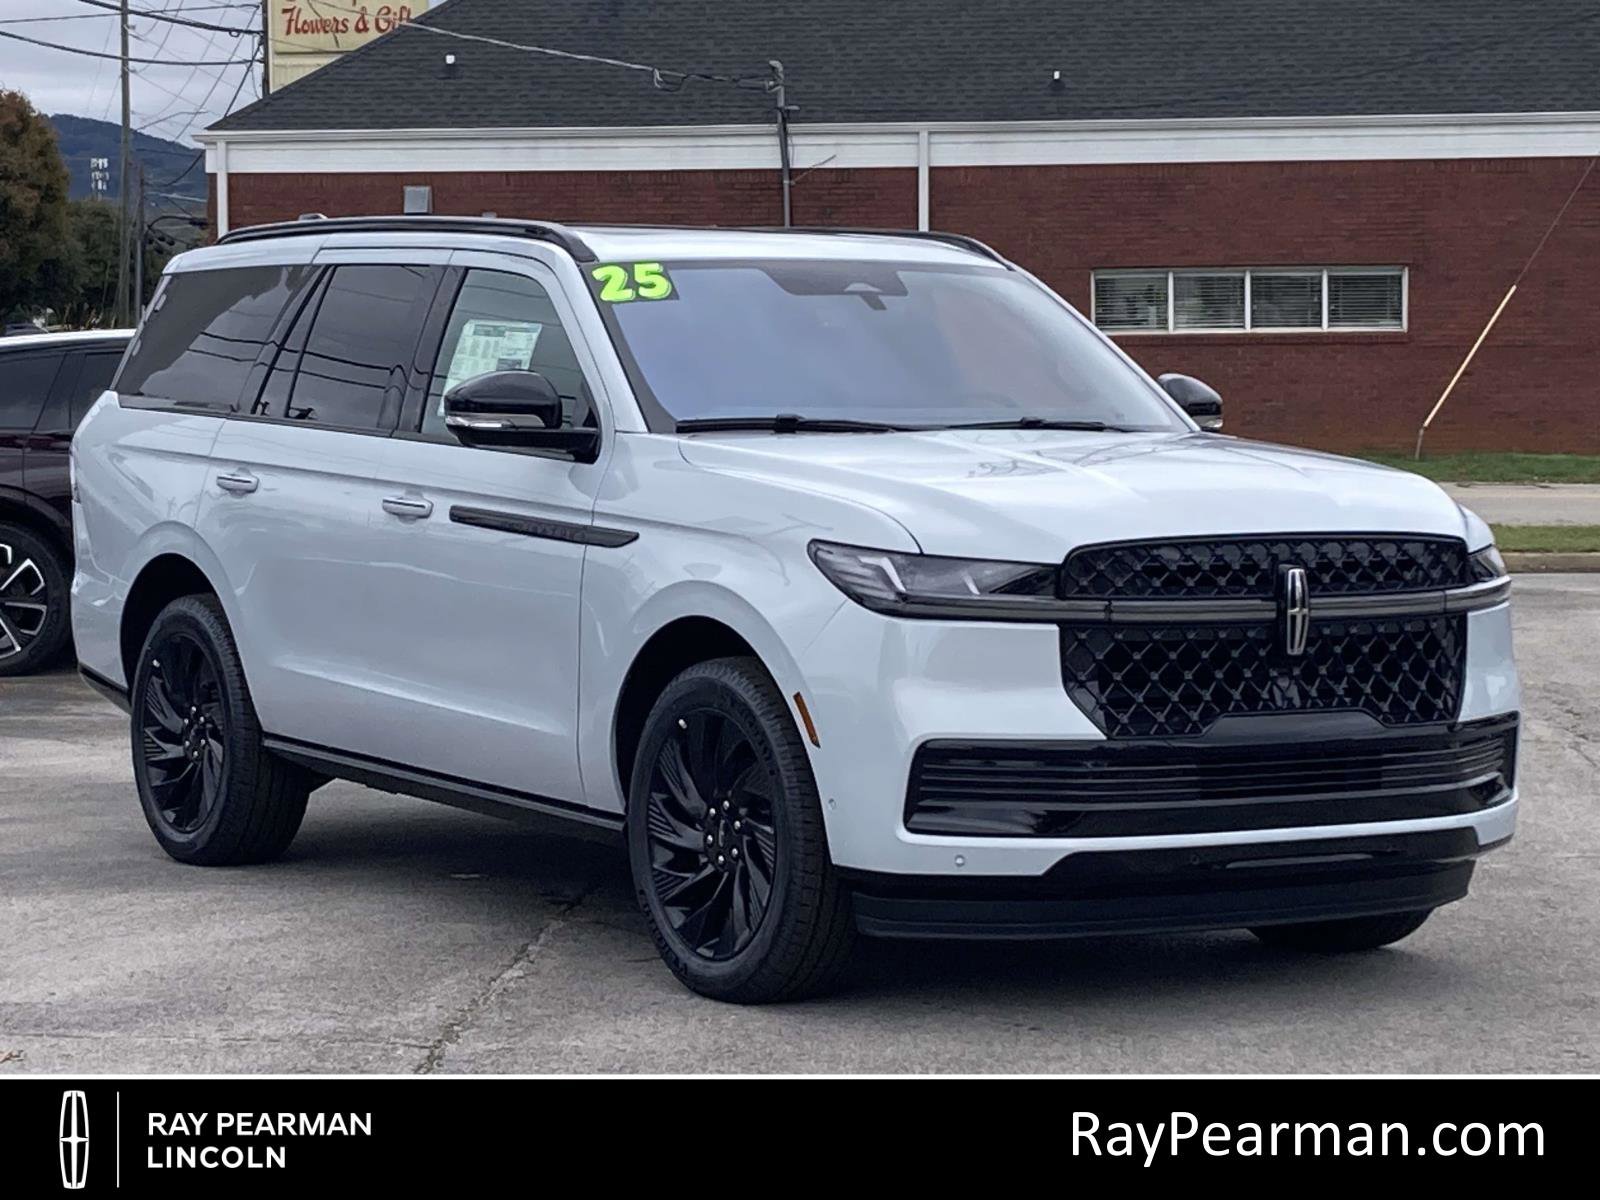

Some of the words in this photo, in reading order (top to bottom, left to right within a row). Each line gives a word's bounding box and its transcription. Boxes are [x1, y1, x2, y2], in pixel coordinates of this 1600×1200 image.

[281, 5, 349, 36] Flowers
[354, 6, 369, 34] &
[592, 262, 672, 302] 25
